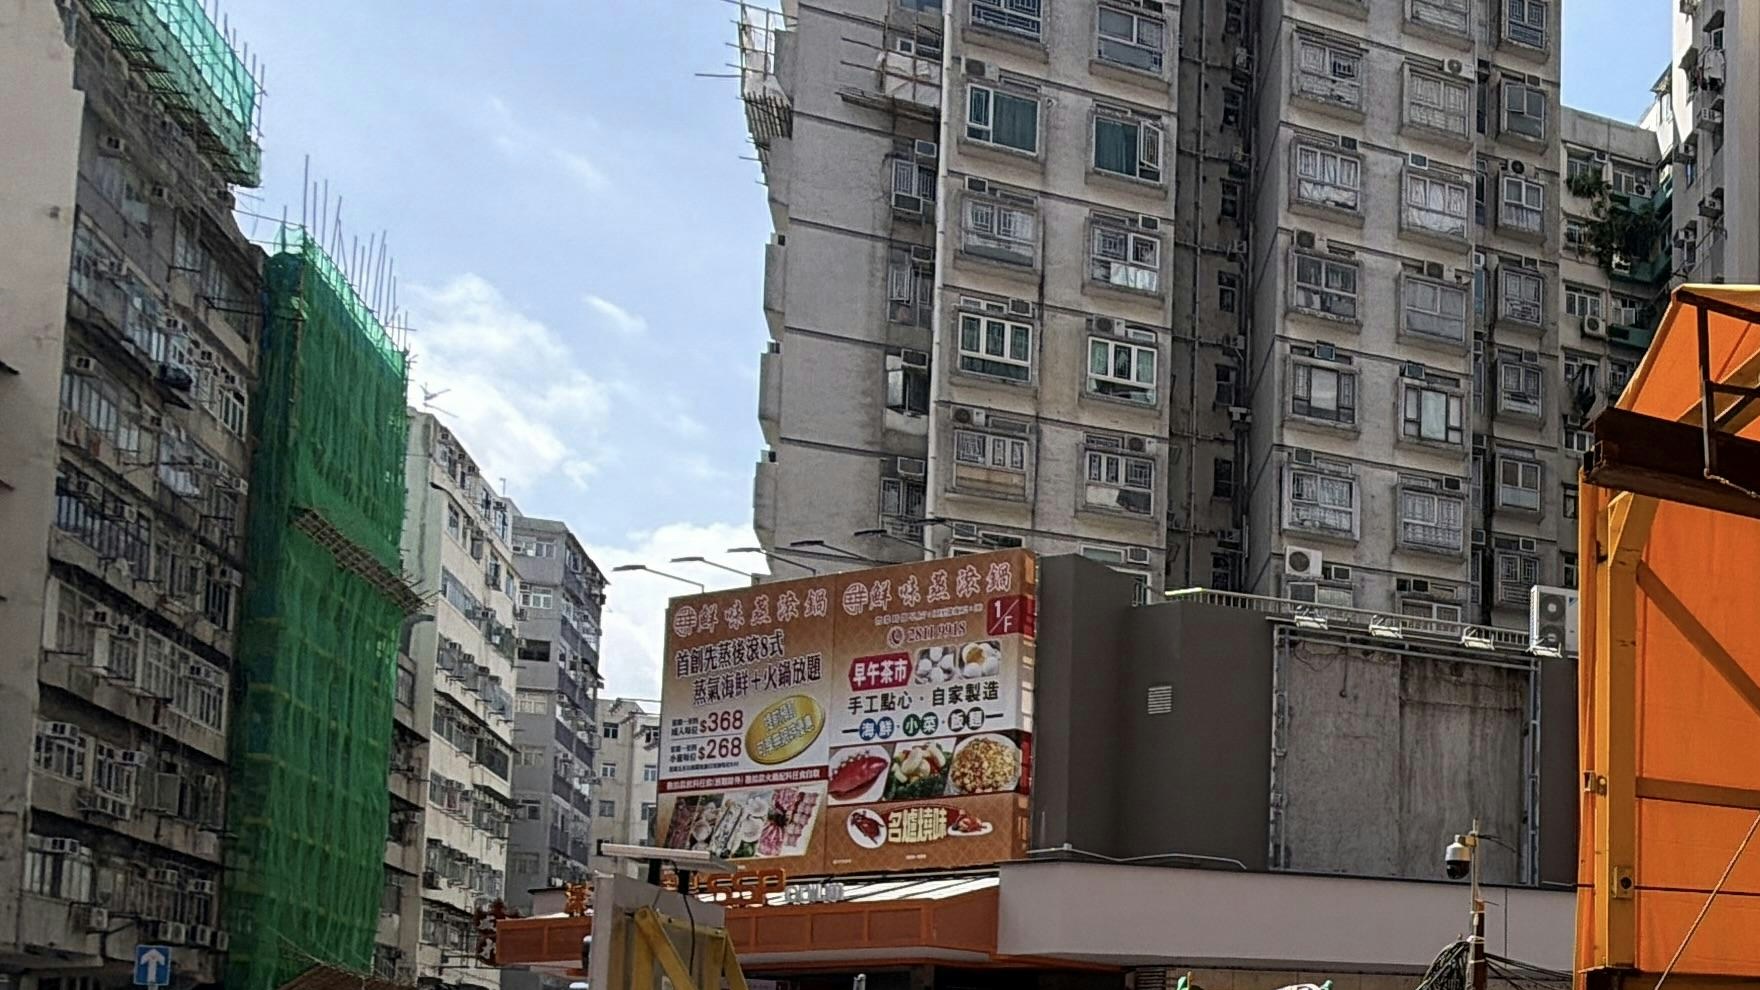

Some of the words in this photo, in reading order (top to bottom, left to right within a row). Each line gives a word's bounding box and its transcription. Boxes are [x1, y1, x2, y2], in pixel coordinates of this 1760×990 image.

[853, 658, 908, 687] 早午茶市
[700, 709, 744, 733] $368
[698, 736, 742, 760] $268
